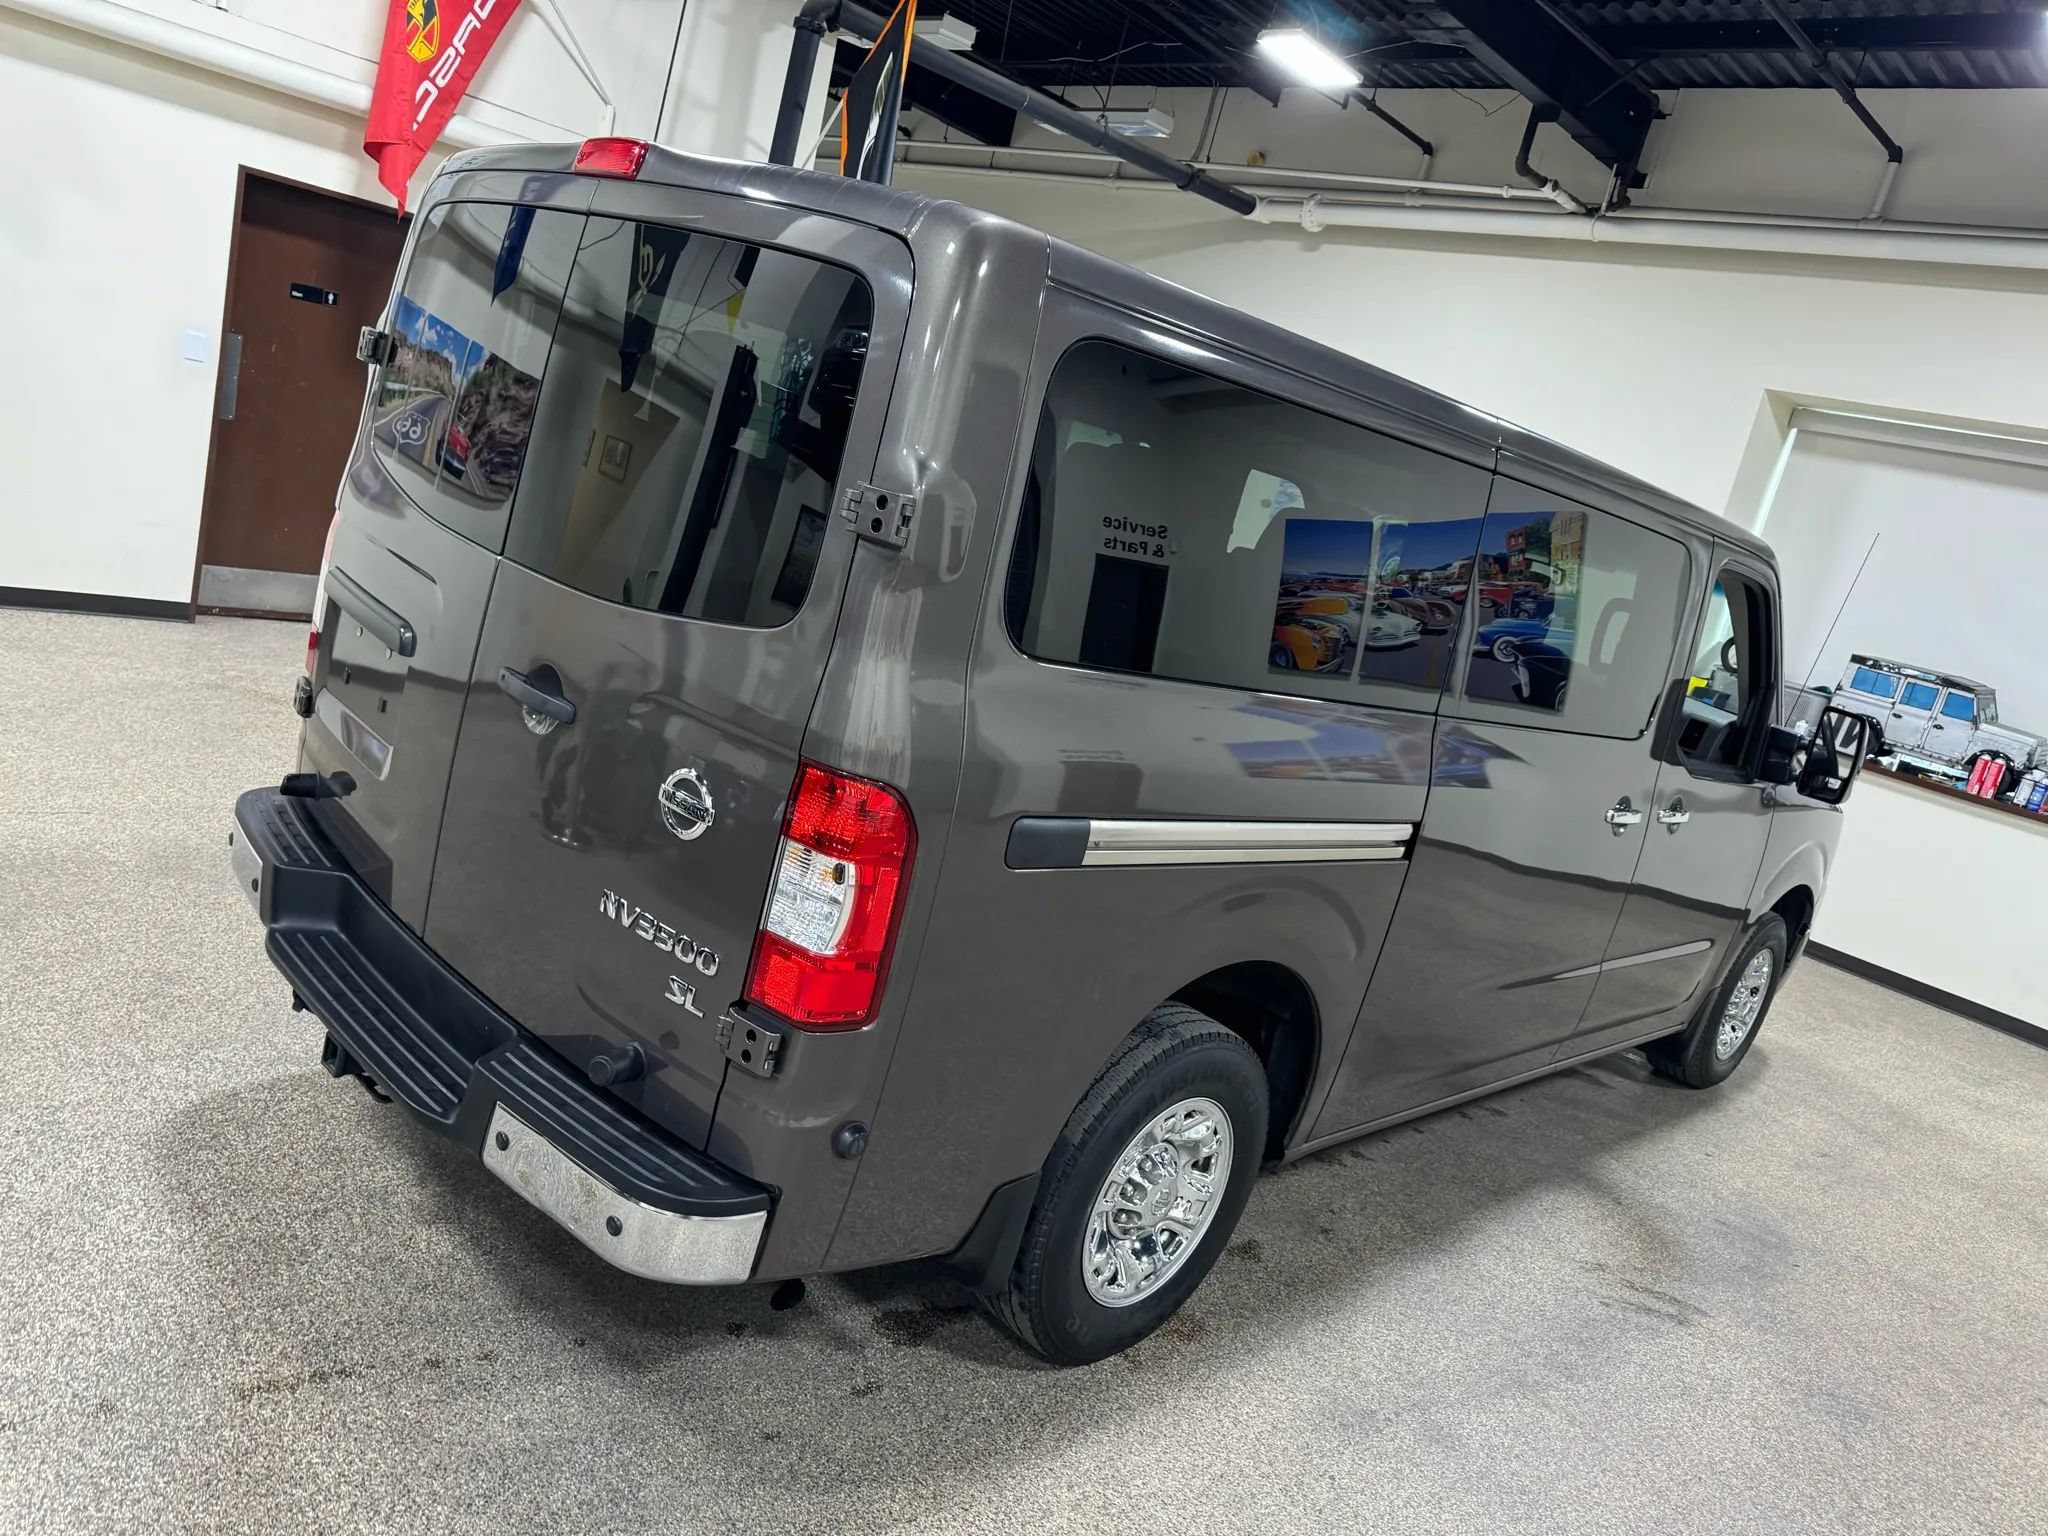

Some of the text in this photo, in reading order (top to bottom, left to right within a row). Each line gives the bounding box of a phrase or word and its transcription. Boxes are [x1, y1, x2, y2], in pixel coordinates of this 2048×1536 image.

[660, 786, 712, 824] NISSAN
[599, 888, 720, 976] NV3500
[664, 975, 705, 1018] SL
